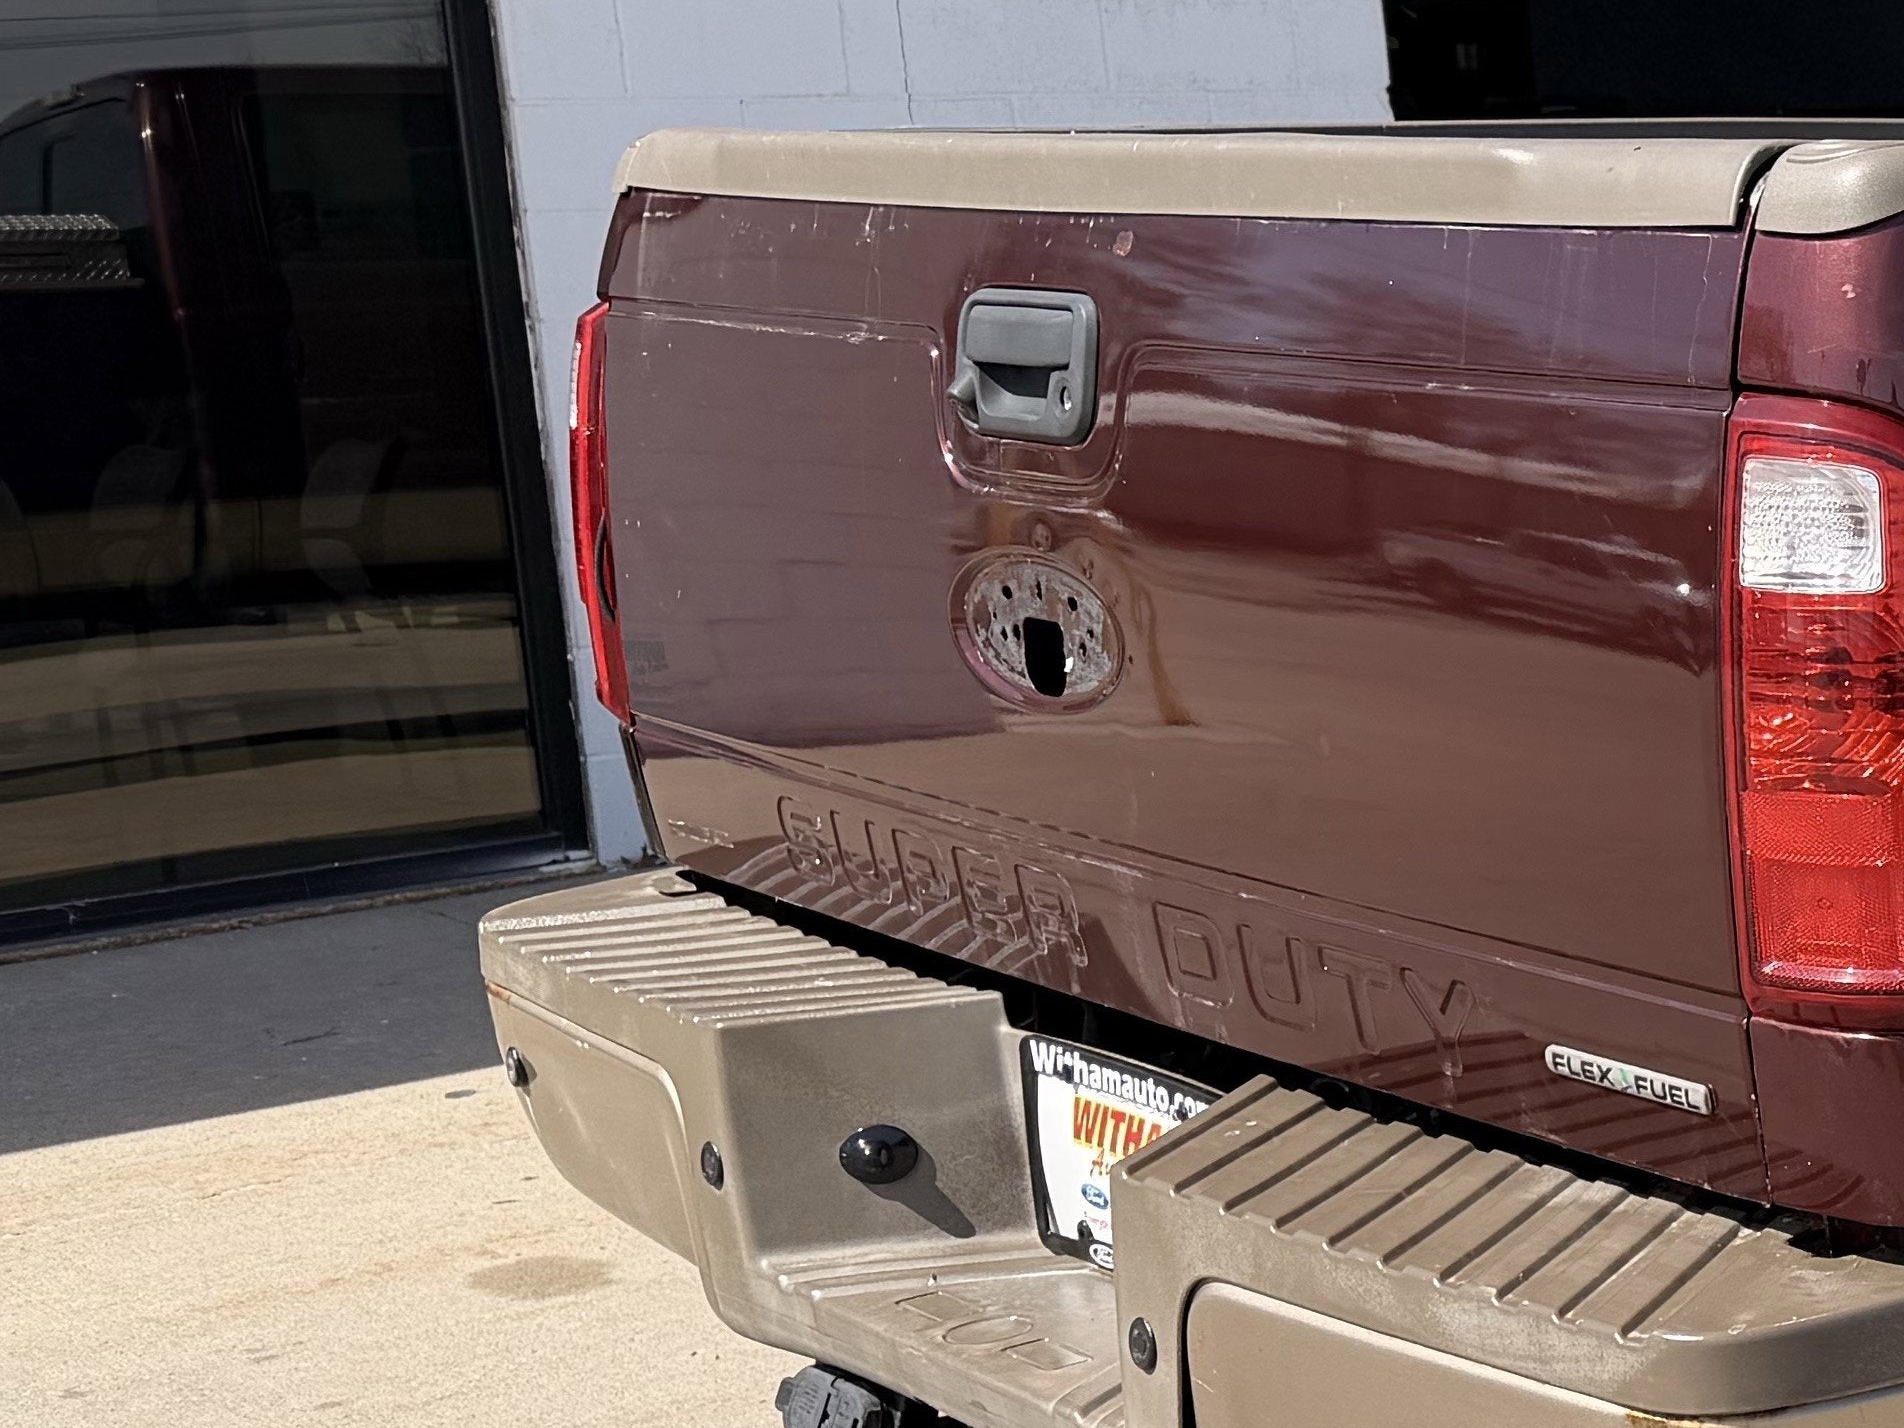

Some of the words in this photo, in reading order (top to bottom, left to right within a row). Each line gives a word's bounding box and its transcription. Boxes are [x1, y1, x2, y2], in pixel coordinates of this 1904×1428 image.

[776, 795, 1088, 968] SUPER
[1153, 899, 1478, 1078] DUTY
[1551, 1052, 1615, 1087] FLEX
[1633, 1074, 1701, 1110] FUEL
